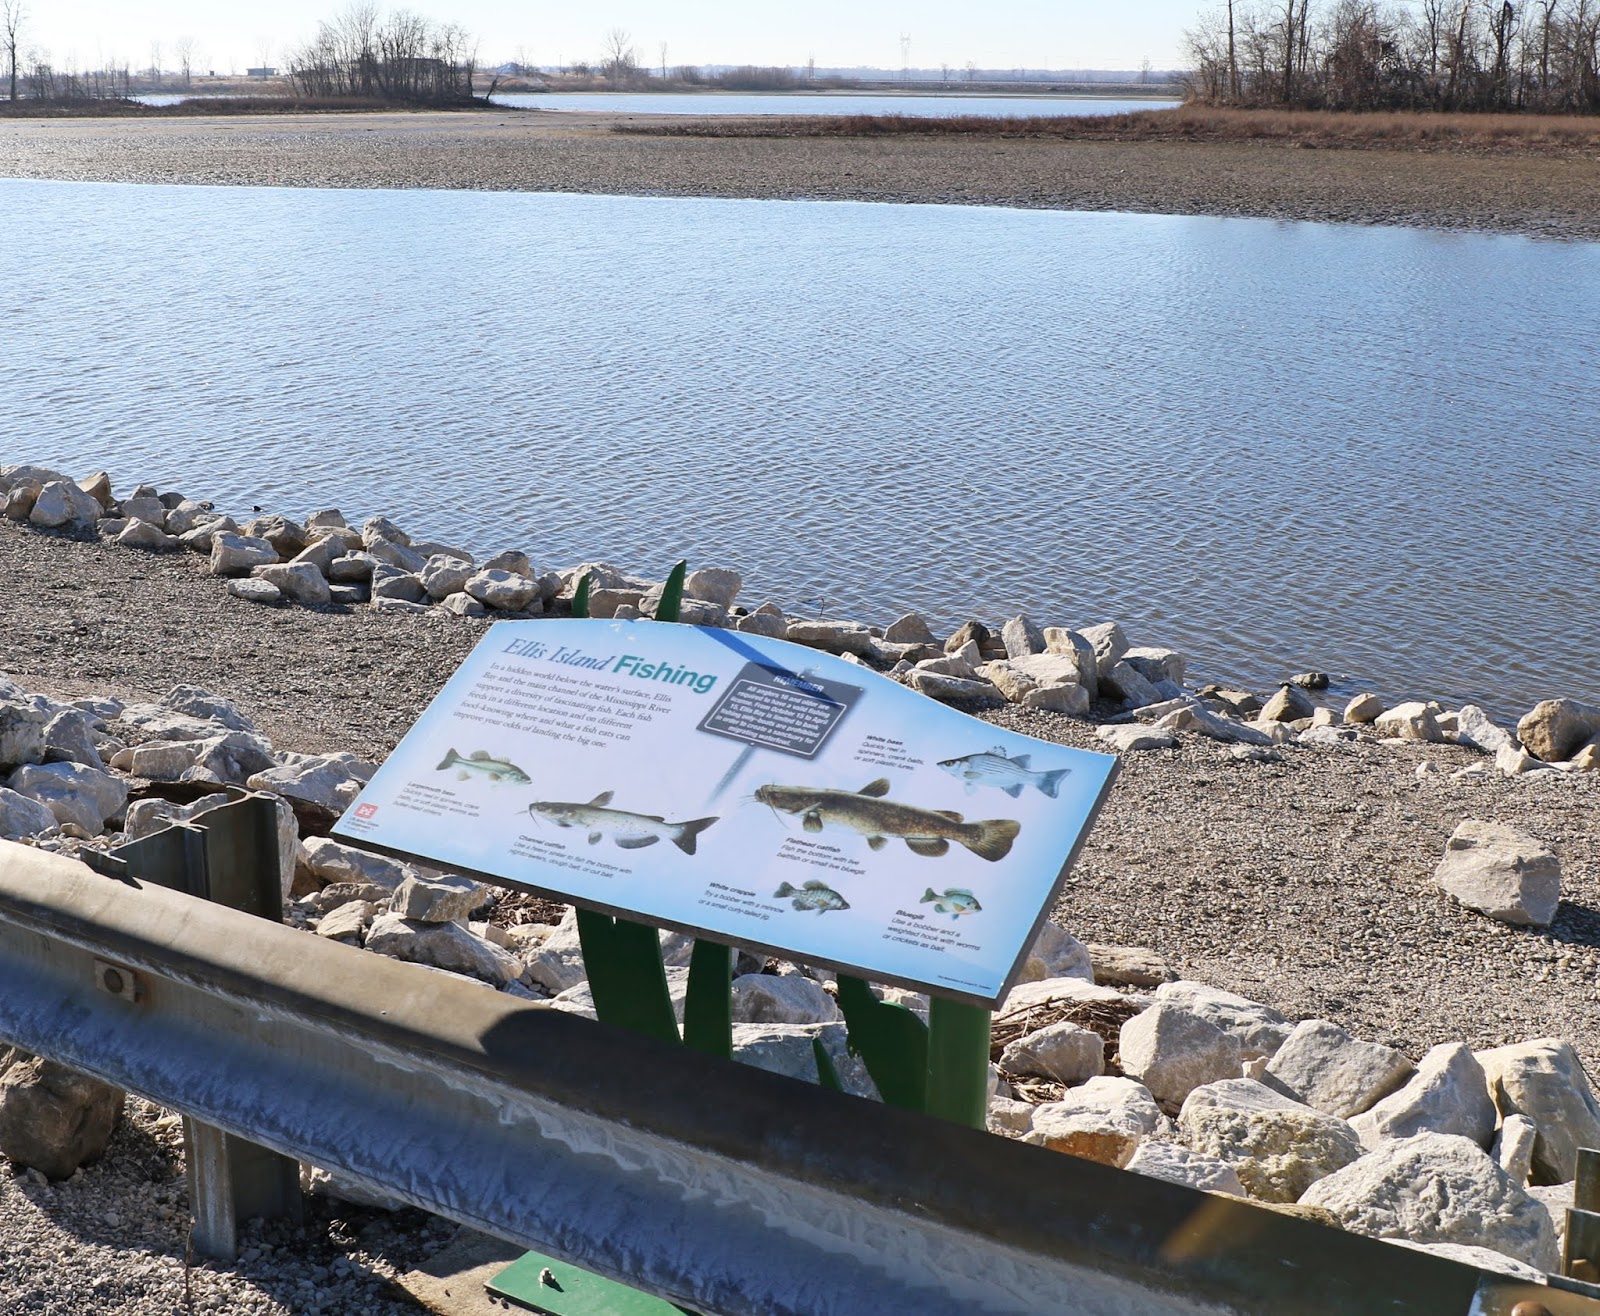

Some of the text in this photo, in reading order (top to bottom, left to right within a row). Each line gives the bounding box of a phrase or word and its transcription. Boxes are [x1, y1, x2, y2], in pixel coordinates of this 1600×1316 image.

[501, 638, 717, 694] Ellis Island Fishing
[490, 662, 500, 670] In
[506, 665, 532, 675] hidden
[533, 672, 556, 680] world
[555, 675, 579, 684] below
[594, 684, 620, 693] water's
[621, 689, 651, 699] surface,
[653, 693, 672, 702] Ellis
[475, 683, 504, 692] support
[511, 688, 544, 701] diversity
[554, 697, 596, 712] fascinating
[596, 705, 612, 714] fish.
[615, 709, 635, 718] Each
[637, 713, 652, 722] fish
[482, 672, 497, 681] Bay
[527, 682, 547, 690] main
[547, 685, 579, 696] channel
[603, 695, 648, 710] Mississippi
[648, 703, 671, 714] River
[756, 689, 780, 698] anglers
[468, 690, 488, 700] feeds
[504, 698, 537, 710] different
[537, 705, 568, 716] location
[597, 717, 633, 729] different
[738, 691, 763, 701] required
[771, 699, 786, 707] have
[808, 708, 830, 719] fishing
[754, 702, 771, 710] From
[770, 706, 797, 716] October
[811, 717, 829, 725] April
[453, 710, 484, 722] improve
[531, 726, 562, 740] landing
[562, 733, 576, 741] the
[577, 735, 590, 746] big
[516, 712, 538, 722] where
[556, 721, 575, 729] what
[582, 725, 597, 734] fish
[720, 708, 742, 719] fishing
[786, 726, 820, 738] prohibited
[722, 715, 740, 725] order
[746, 723, 767, 732] create
[770, 730, 804, 742] sanctuary
[753, 709, 766, 717] Bay
[773, 714, 796, 724] limited
[802, 722, 819, 730] bank
[727, 727, 758, 738] migrating
[867, 735, 886, 743] White
[862, 741, 885, 750] Quickly
[519, 834, 566, 850] Channel catfish
[781, 844, 795, 852] Fish
[807, 850, 832, 860] bottom
[785, 837, 841, 853] Flathead catfish
[531, 845, 548, 854] heavy
[548, 850, 567, 858] sinker
[596, 862, 619, 872] bottom
[548, 858, 569, 868] dough
[776, 852, 801, 861] baitfish
[709, 882, 756, 897] White crappie
[704, 890, 713, 898] Try
[719, 894, 741, 903] bobber
[761, 904, 785, 913] minnow
[711, 901, 729, 910] small
[896, 909, 925, 920] Bluegill
[892, 917, 907, 925] Use
[912, 920, 940, 932] bobber
[940, 928, 956, 936] and
[887, 926, 981, 951] weighted hook with worms
[891, 935, 919, 947] crickets
